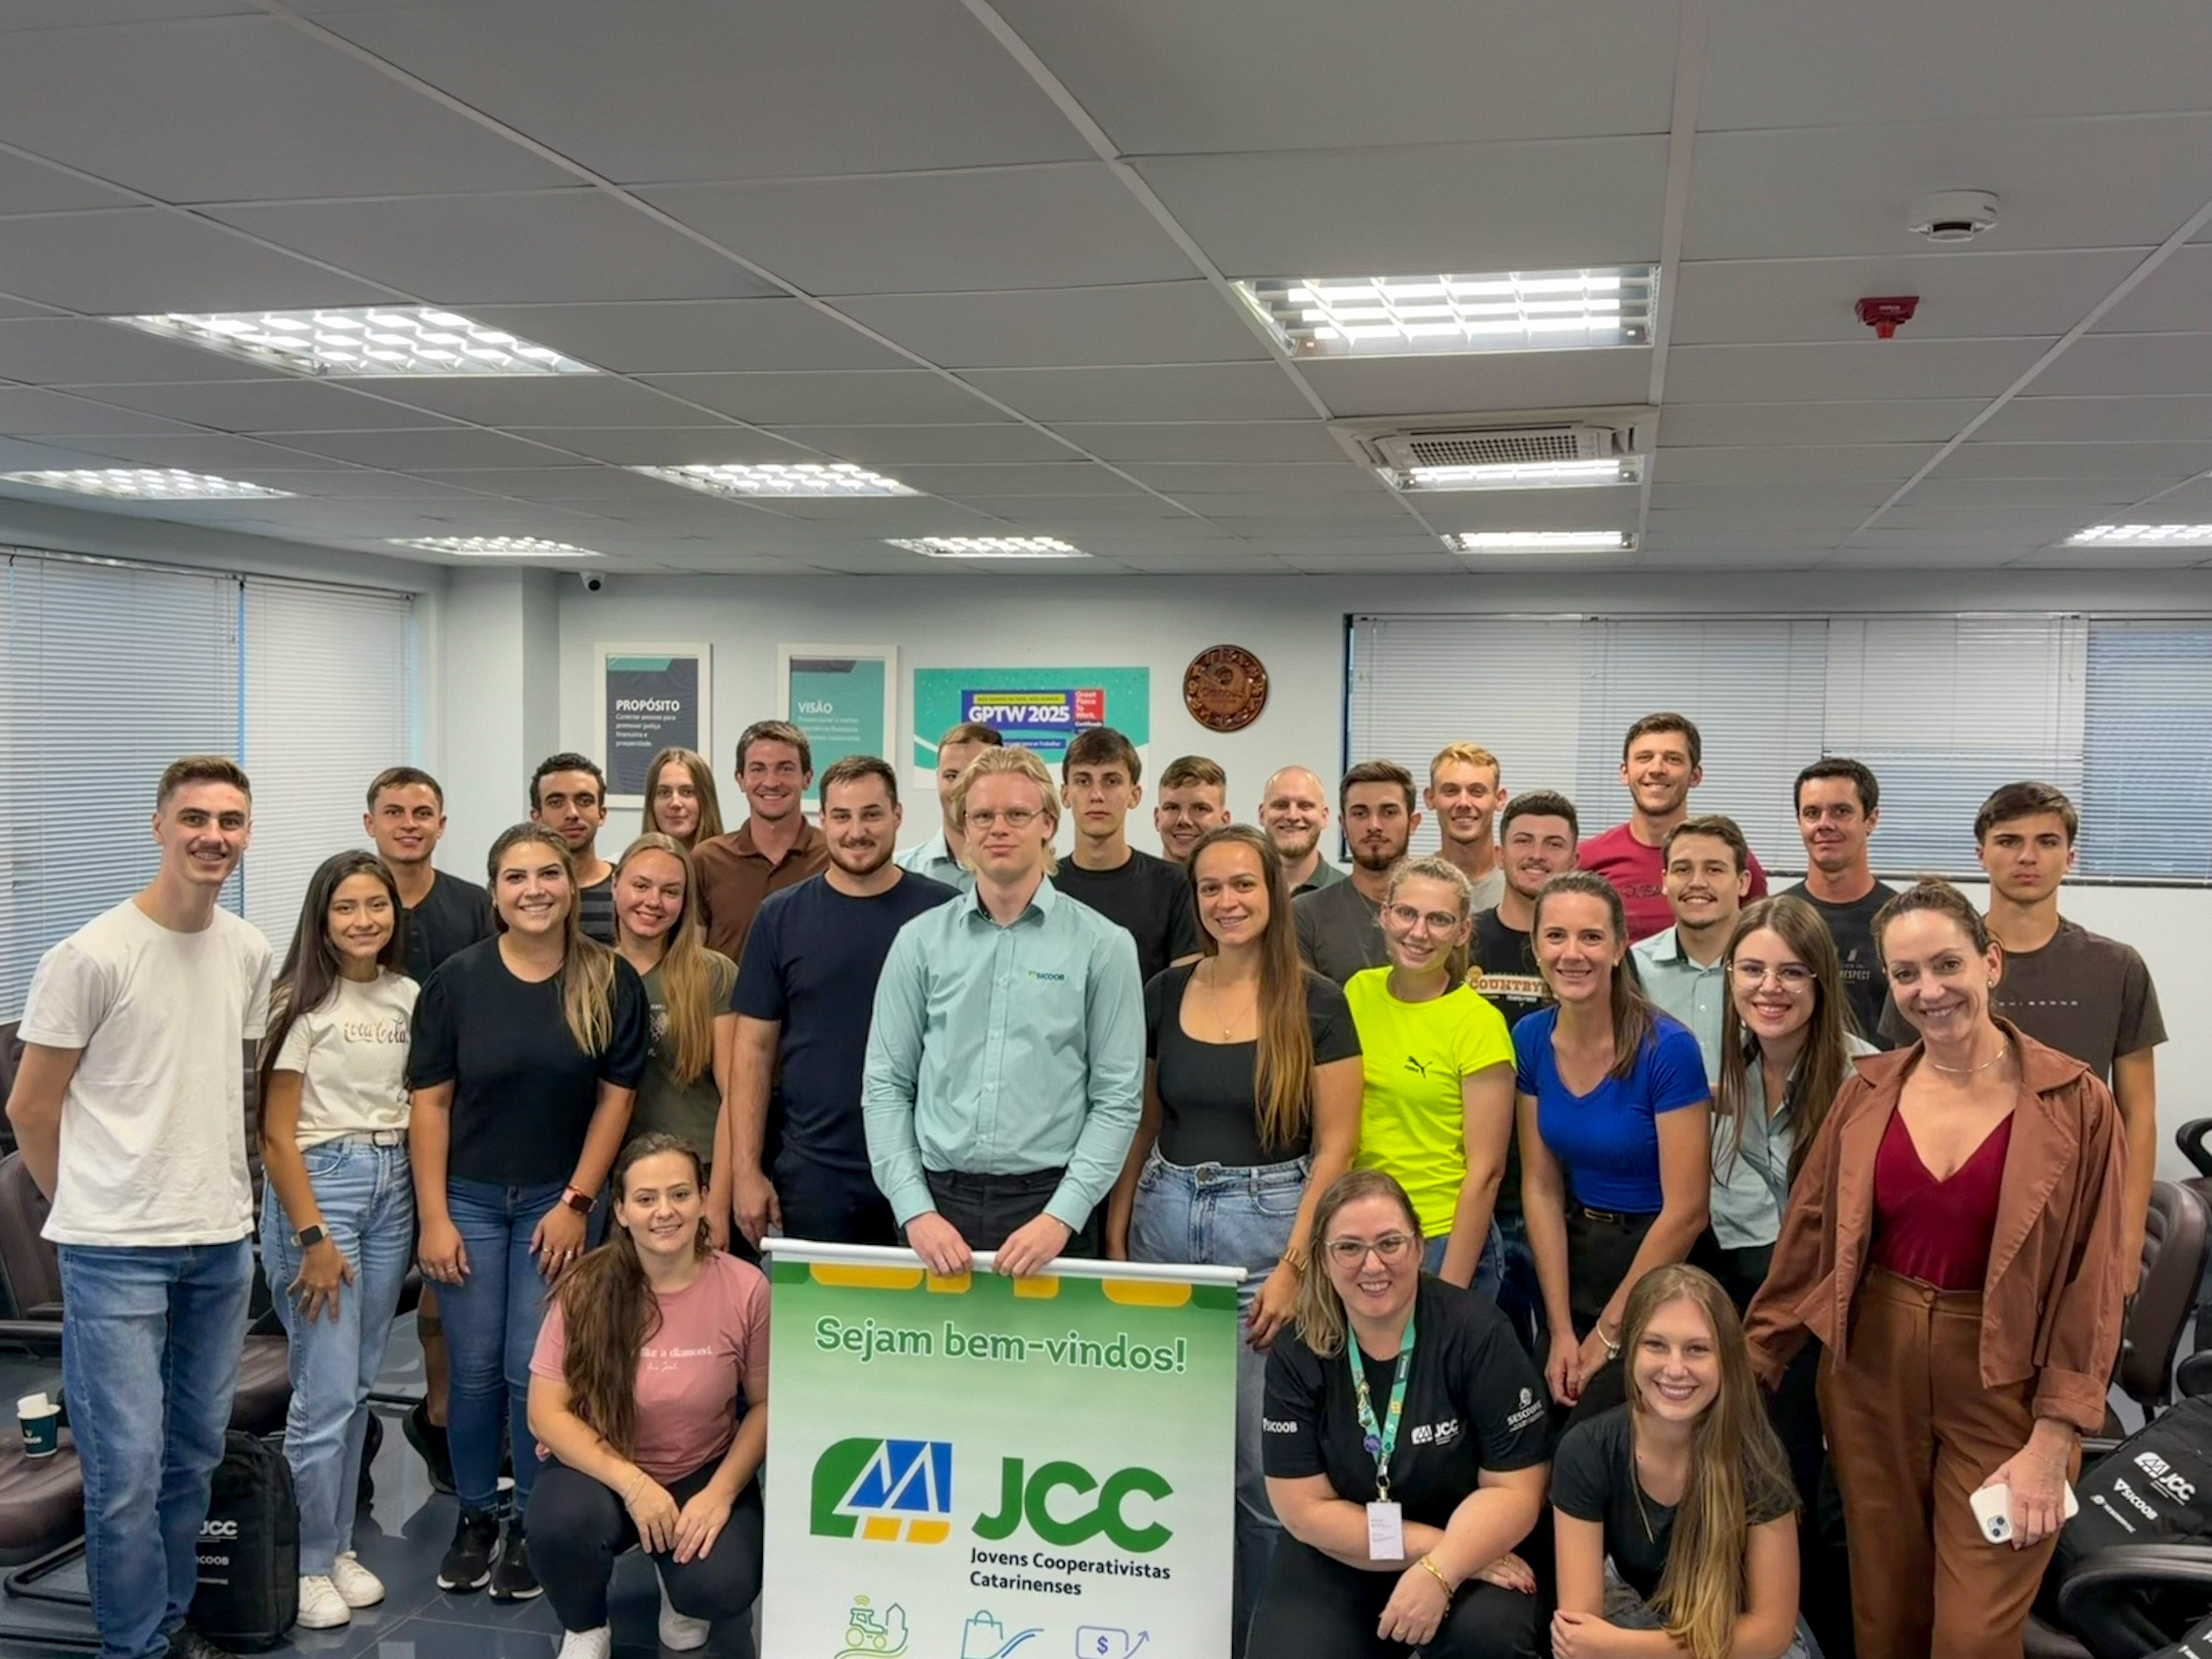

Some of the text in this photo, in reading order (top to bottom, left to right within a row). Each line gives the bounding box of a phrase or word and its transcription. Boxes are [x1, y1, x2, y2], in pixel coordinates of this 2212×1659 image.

[616, 697, 680, 712] PROPÓSITO
[798, 700, 833, 714] VISÃO
[969, 706, 1070, 723] GPTW 2025
[1037, 972, 1064, 981] SICOOB
[1471, 979, 1540, 991] COUNTRY
[816, 1316, 1187, 1373] Sejam bem-vindos!
[1434, 1418, 1459, 1437] JCC
[2158, 1472, 2197, 1502] JCC
[971, 1457, 1174, 1553] JCC
[2121, 1487, 2159, 1520] SICOOB
[199, 1520, 238, 1535] JCC
[970, 1547, 1171, 1580] Jovens Cooperativistas
[970, 1571, 1082, 1596] Catarinenses
